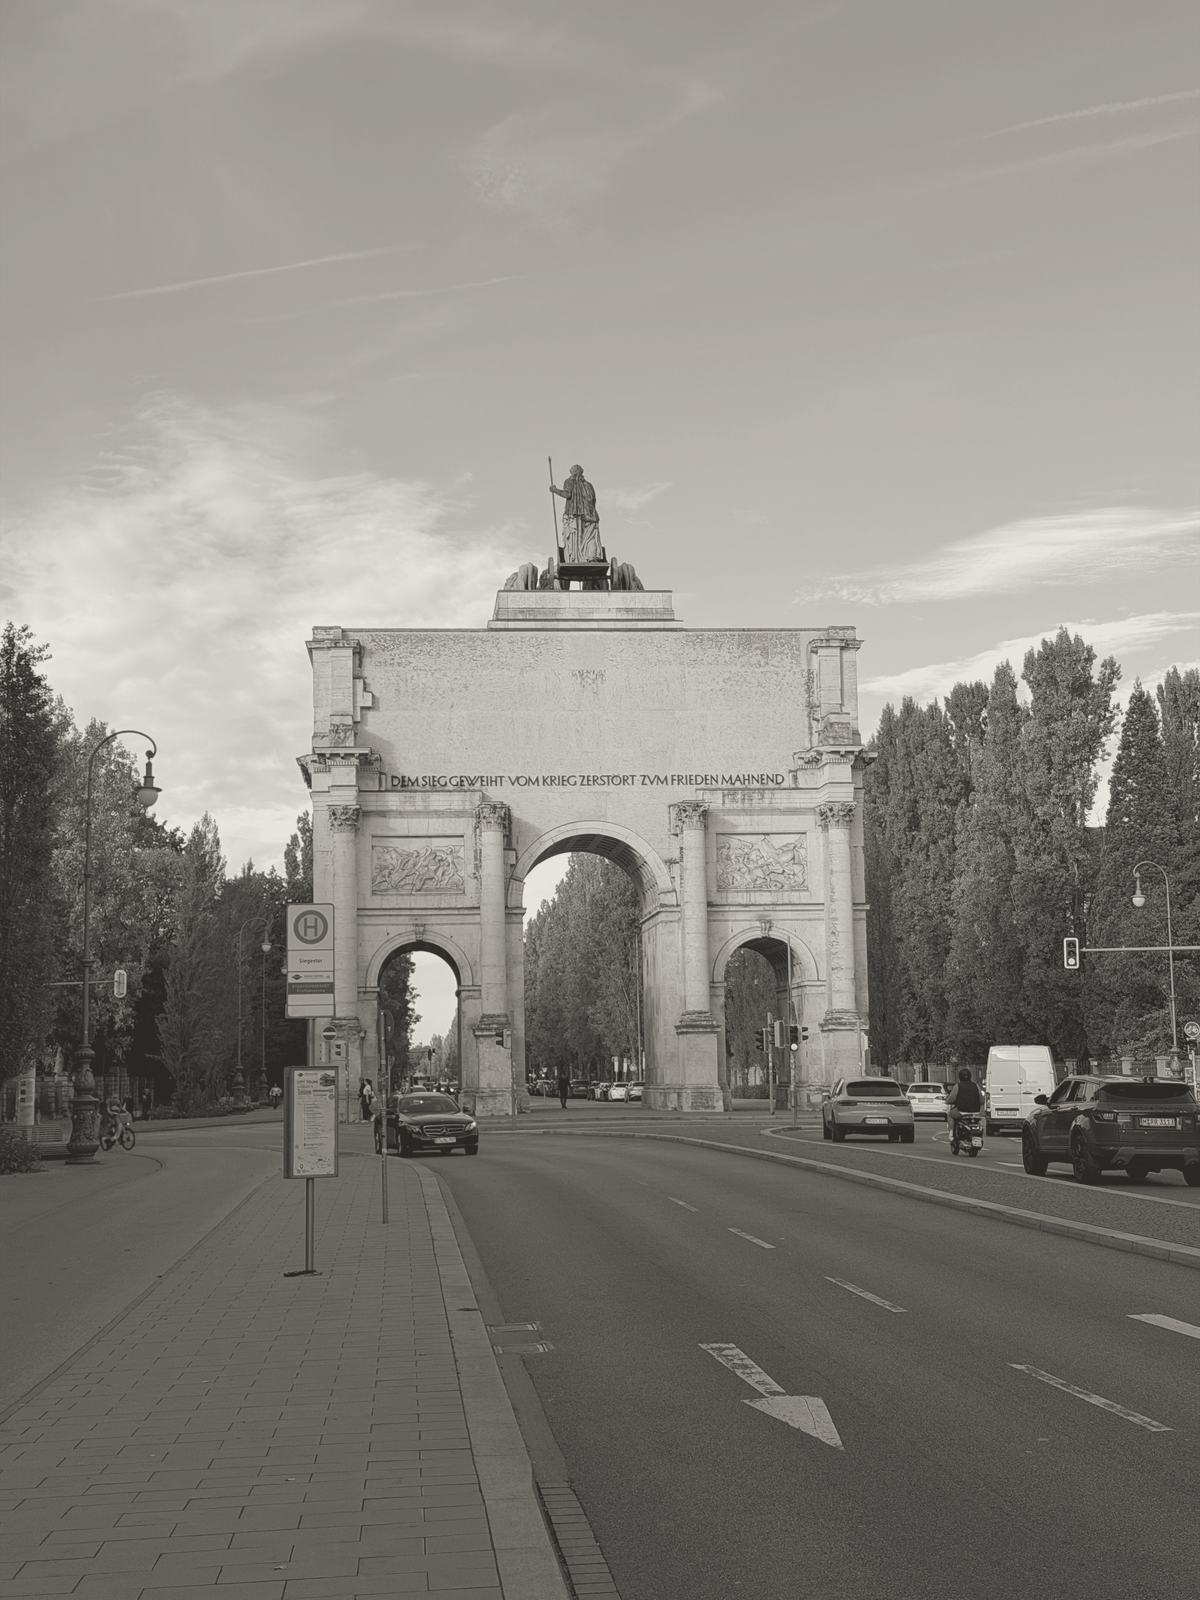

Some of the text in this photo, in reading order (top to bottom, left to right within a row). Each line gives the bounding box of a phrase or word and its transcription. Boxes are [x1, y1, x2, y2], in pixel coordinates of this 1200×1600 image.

[391, 775, 420, 787] DEM
[421, 775, 448, 787] SIEG
[449, 775, 505, 787] GEWEIHT
[508, 775, 540, 787] VOM
[542, 775, 577, 787] KRIEG
[640, 774, 668, 786] ZVM
[671, 774, 719, 786] FRIEDEN
[721, 774, 785, 786] MAHNEND
[303, 917, 318, 937] H
